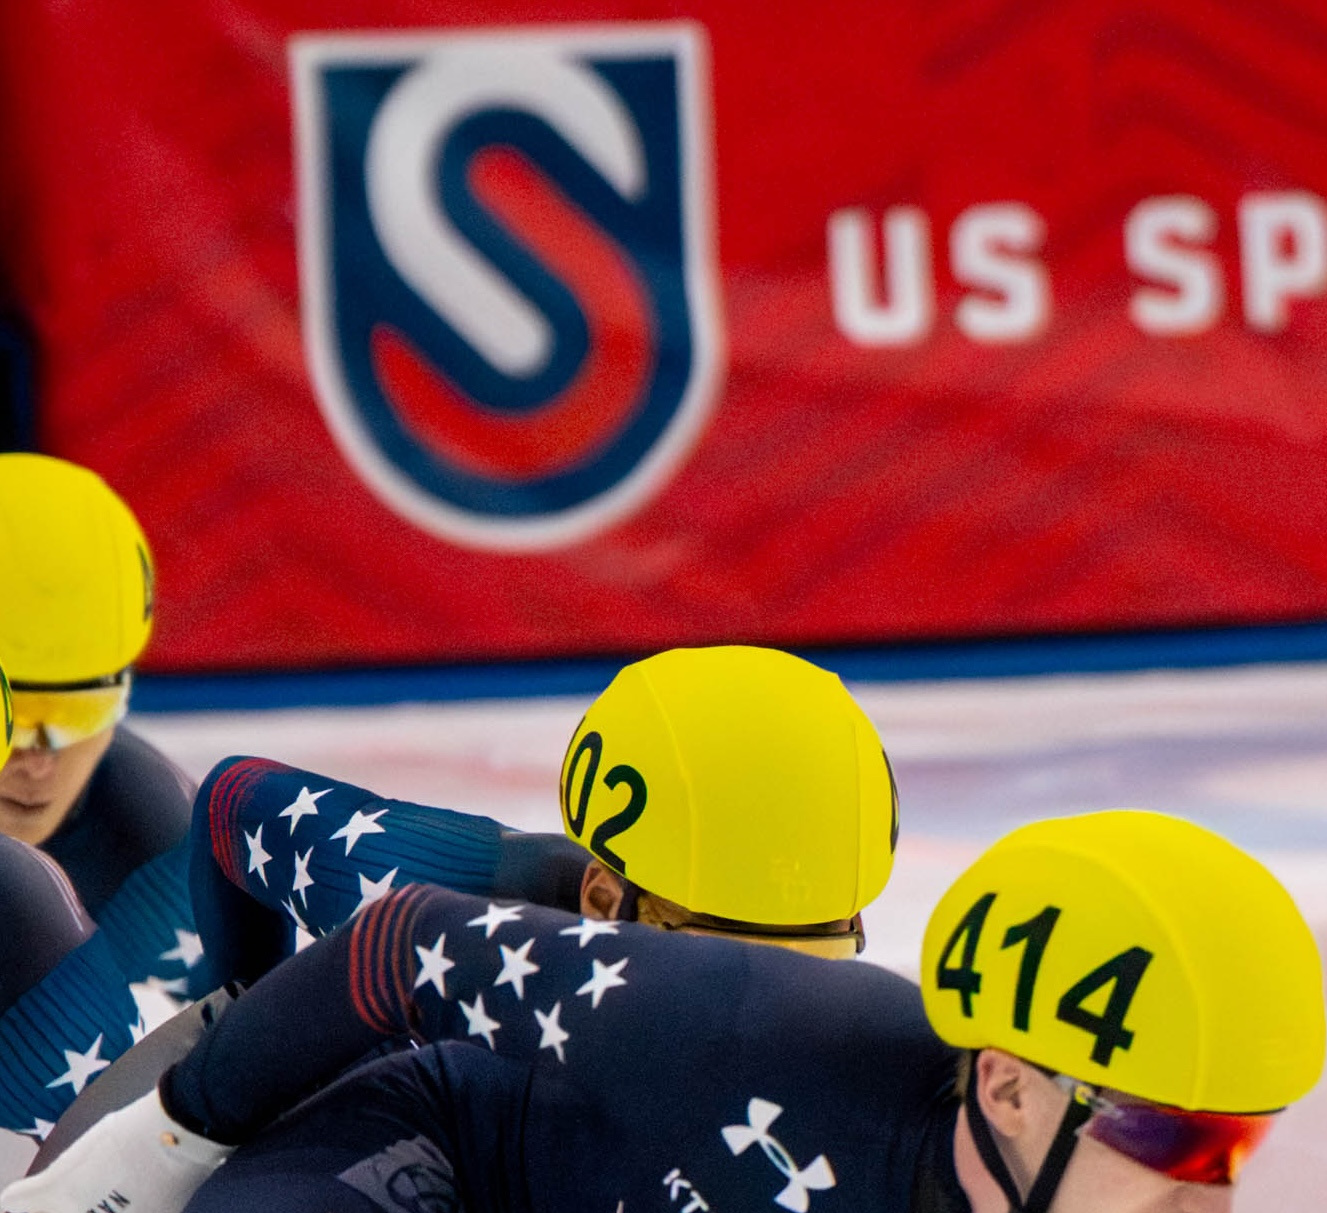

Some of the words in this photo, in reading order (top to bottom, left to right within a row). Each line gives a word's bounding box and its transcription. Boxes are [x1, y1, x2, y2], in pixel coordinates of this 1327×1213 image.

[826, 201, 1053, 347] US
[560, 716, 647, 877] 02
[936, 891, 1154, 1067] 414
